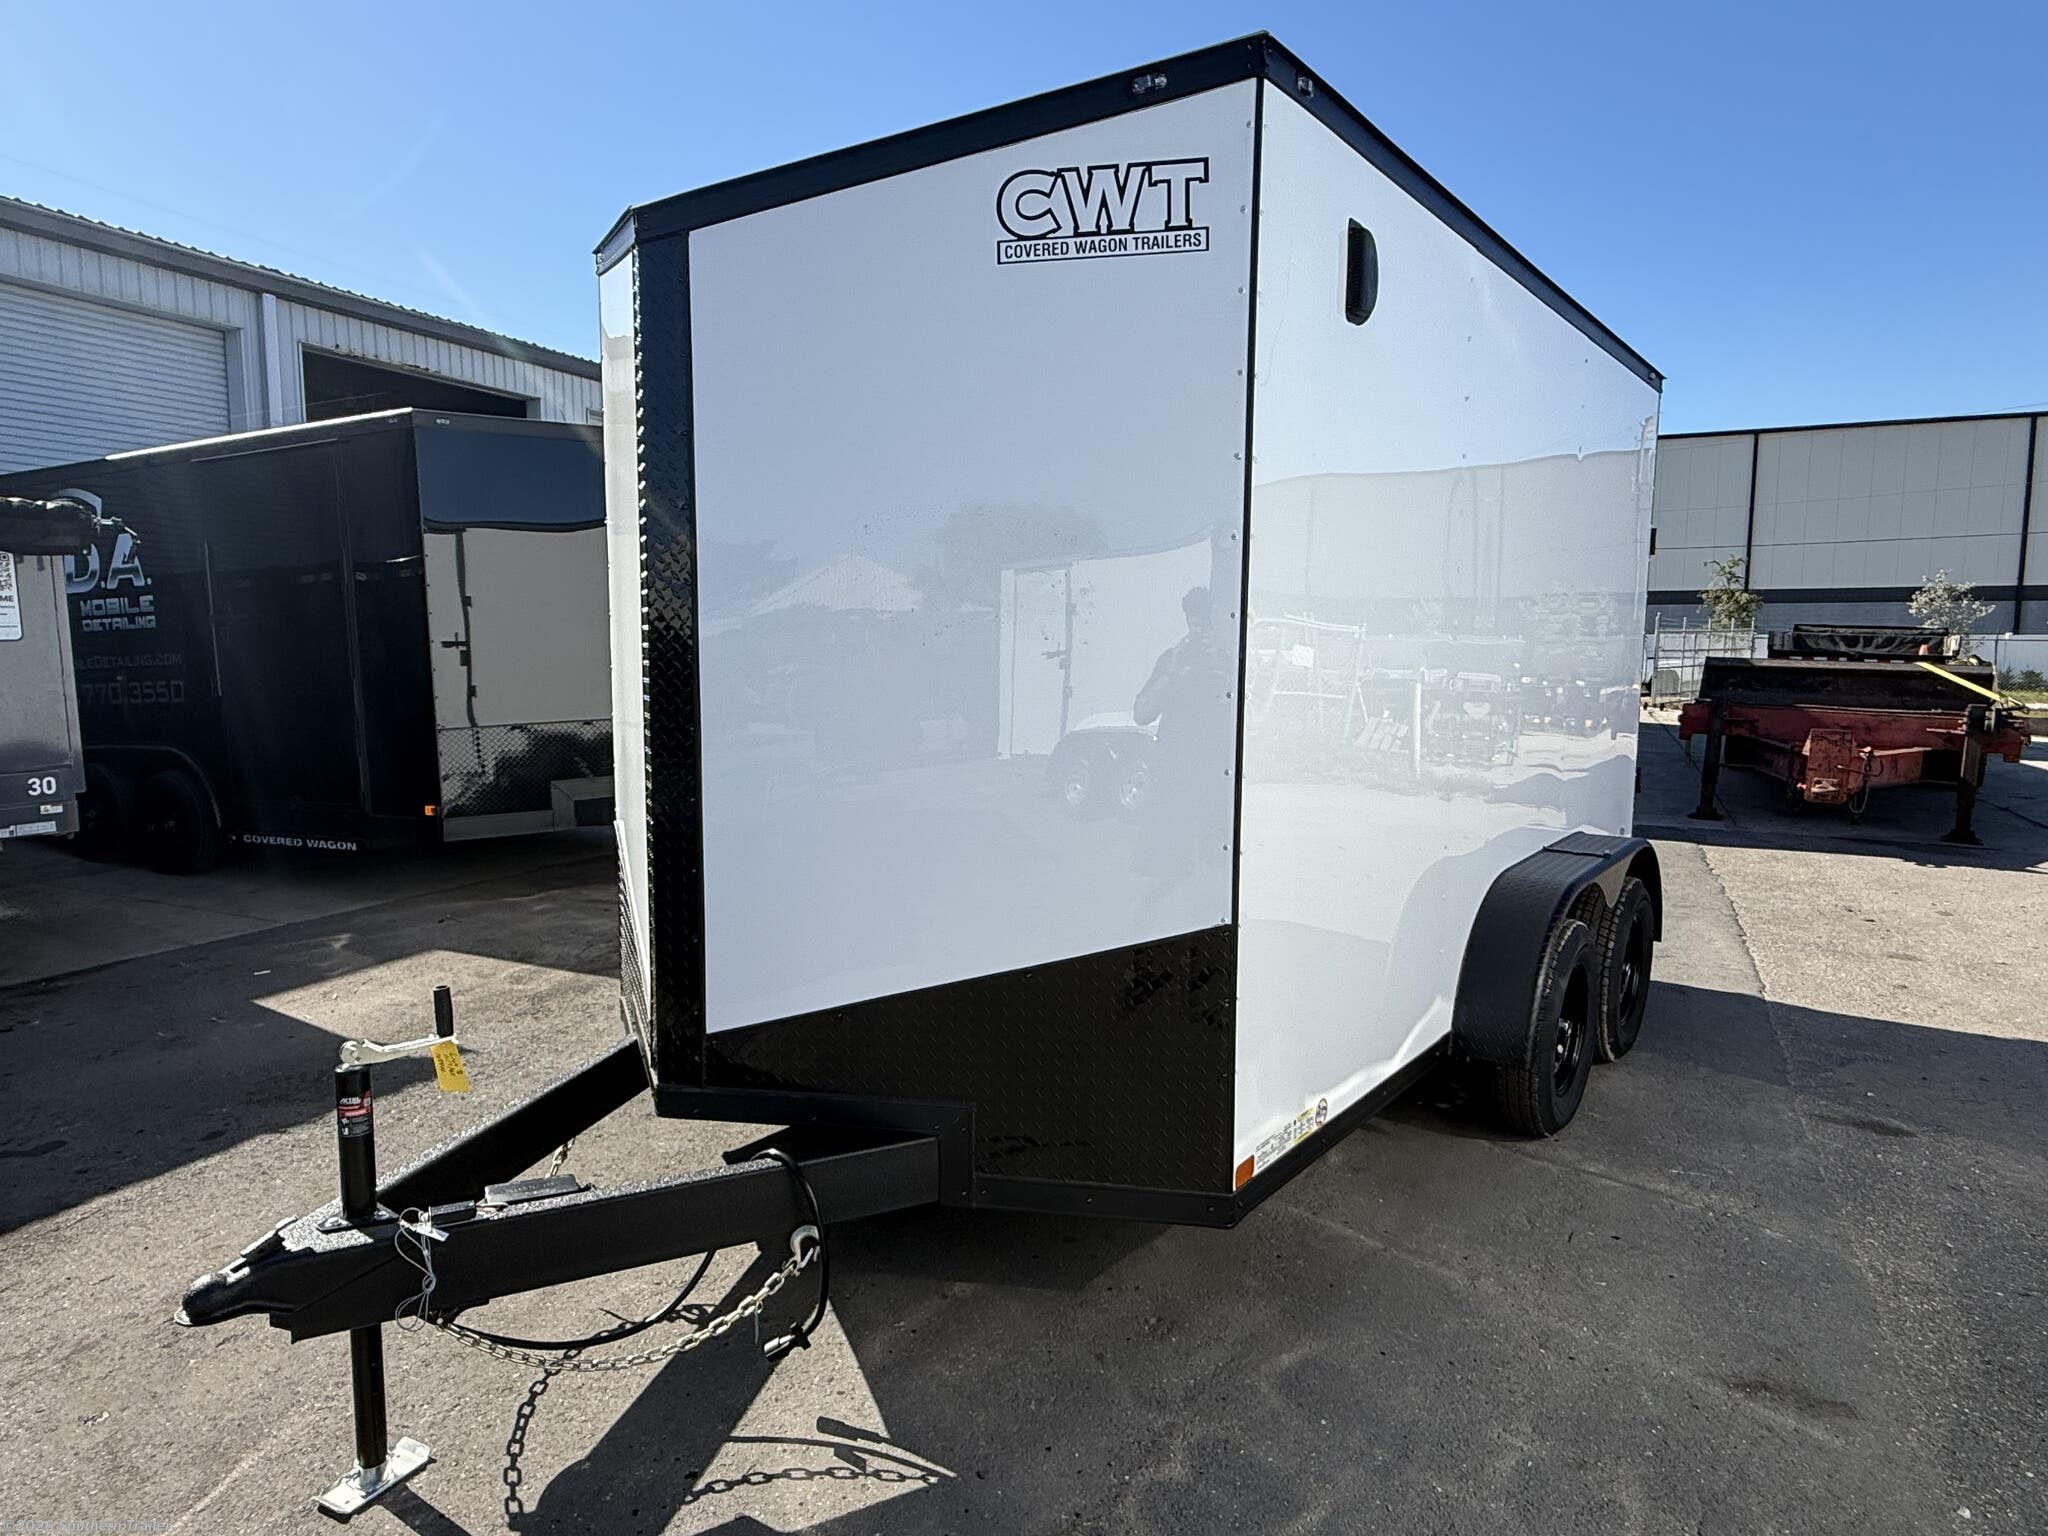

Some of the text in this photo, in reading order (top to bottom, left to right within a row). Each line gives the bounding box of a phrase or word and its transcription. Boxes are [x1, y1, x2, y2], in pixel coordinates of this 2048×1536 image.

[996, 157, 1209, 239] CWT
[1004, 232, 1202, 259] COVERED WAGON TRAILERS
[80, 595, 155, 617] MOBILE
[82, 615, 157, 632] DETAILING
[27, 776, 57, 796] 30
[243, 834, 358, 851] COVERED WAGON
